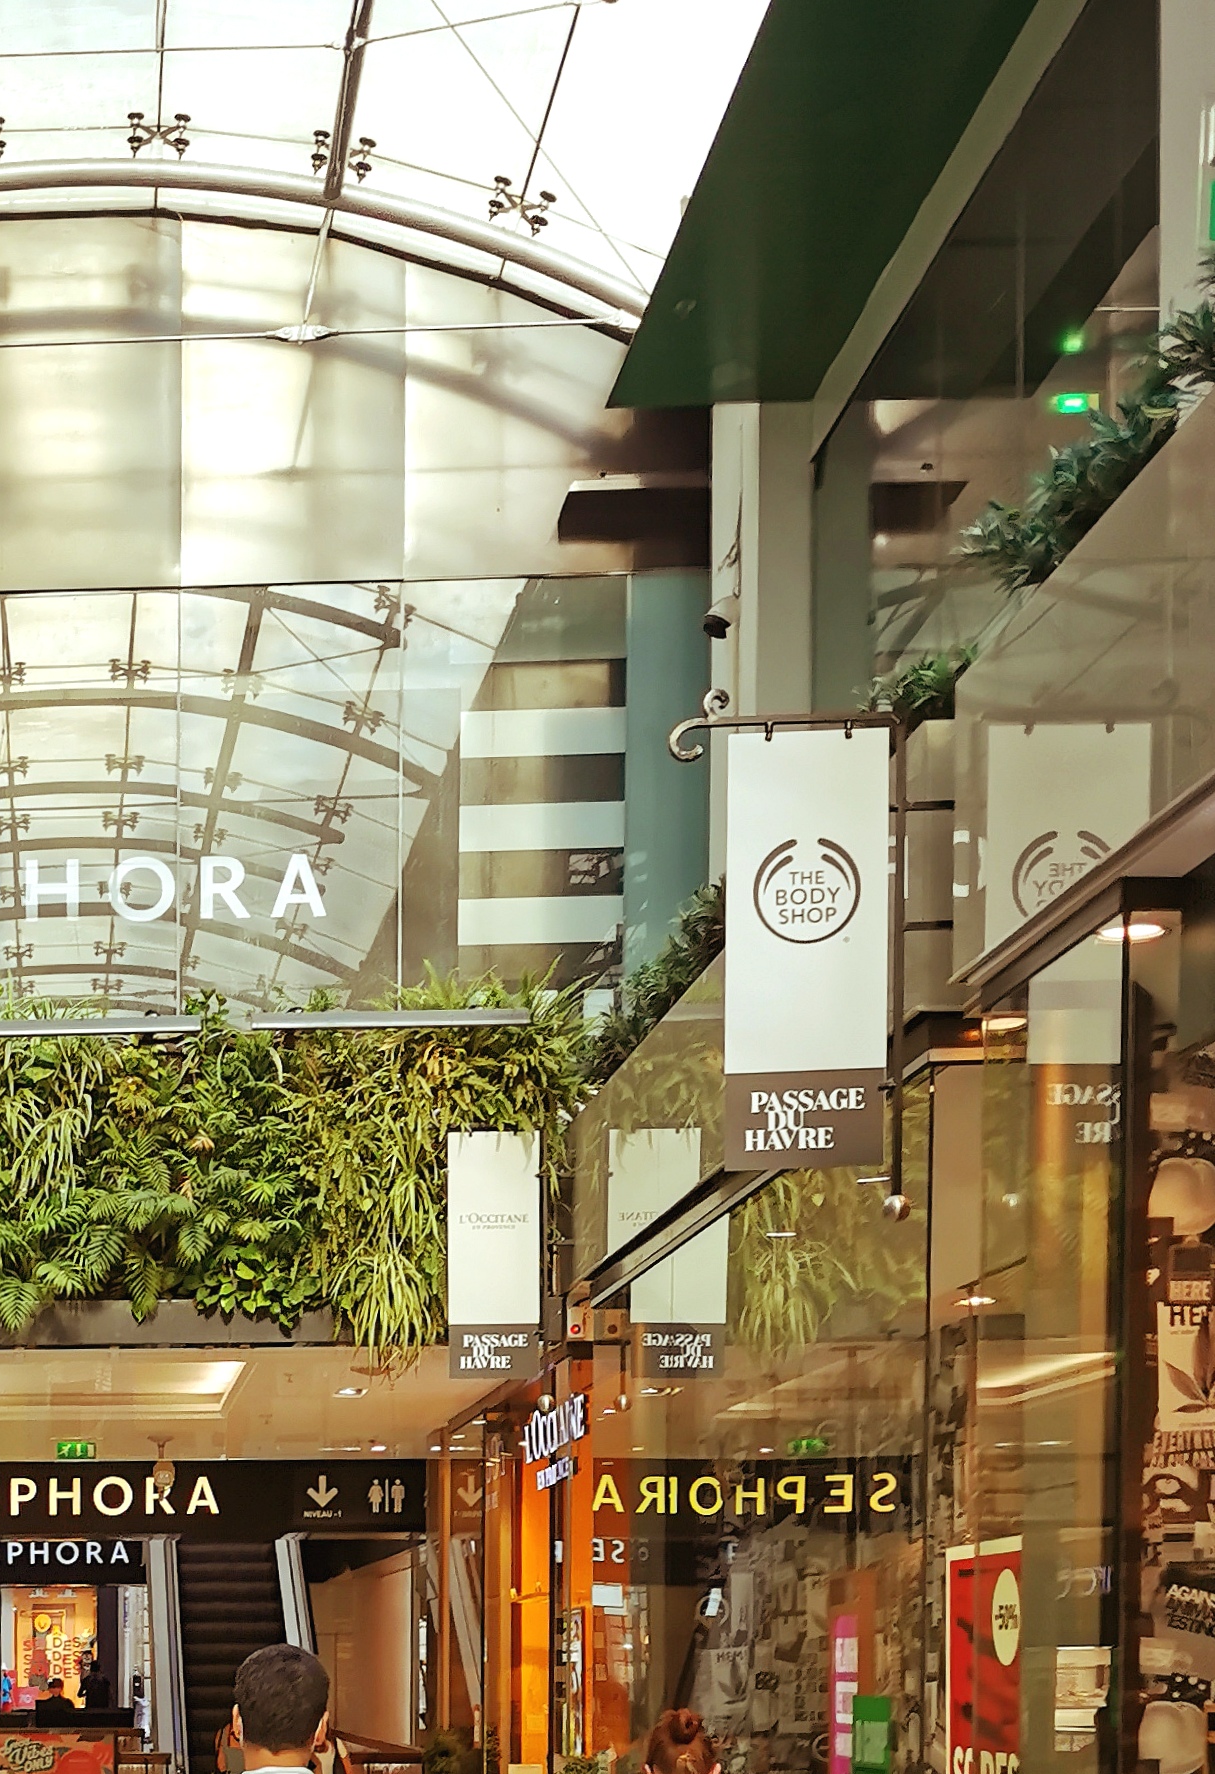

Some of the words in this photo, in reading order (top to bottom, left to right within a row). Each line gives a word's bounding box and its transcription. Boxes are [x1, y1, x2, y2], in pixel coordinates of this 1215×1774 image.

[789, 870, 825, 885] THE
[775, 886, 840, 906] BODY
[778, 907, 837, 925] SHOP
[750, 1087, 866, 1113] PASSAGE
[767, 1110, 804, 1131] DU
[744, 1126, 835, 1151] HAVRE
[463, 1333, 529, 1348] PASSAGE
[472, 1345, 495, 1358] DU
[459, 1356, 512, 1370] HAVRE
[303, 1510, 333, 1519] NIVEAU
